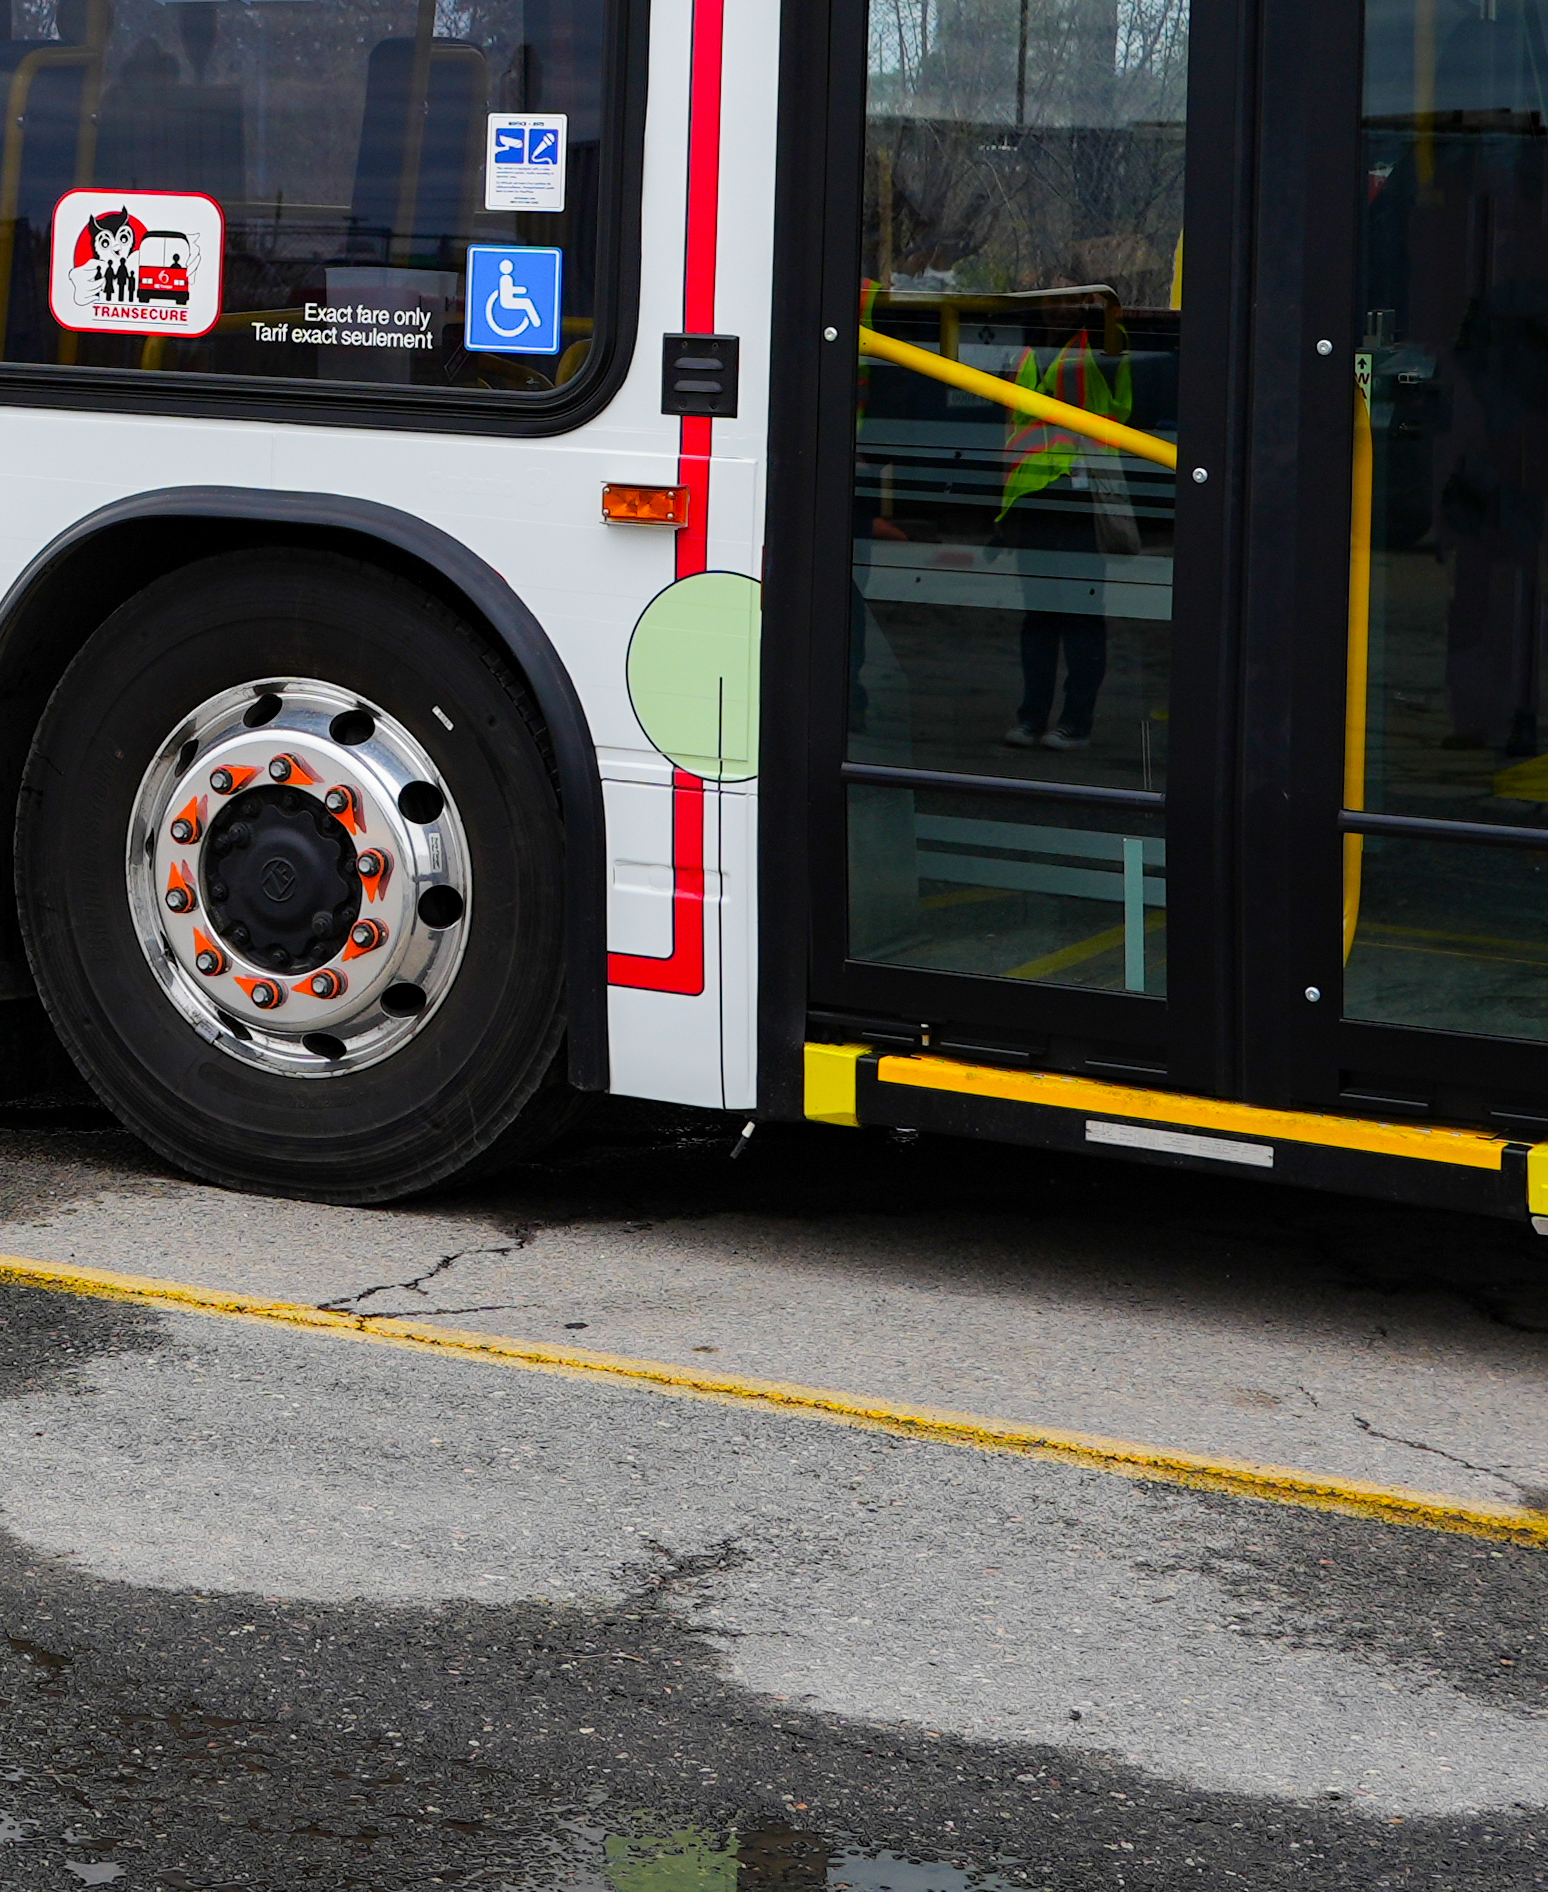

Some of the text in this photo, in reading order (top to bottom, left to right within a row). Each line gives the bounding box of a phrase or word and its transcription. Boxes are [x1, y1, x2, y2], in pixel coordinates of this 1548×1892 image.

[92, 305, 188, 322] TRANSECURE
[304, 302, 431, 331] Exact fare only
[251, 321, 434, 350] Tarif exact seulement
